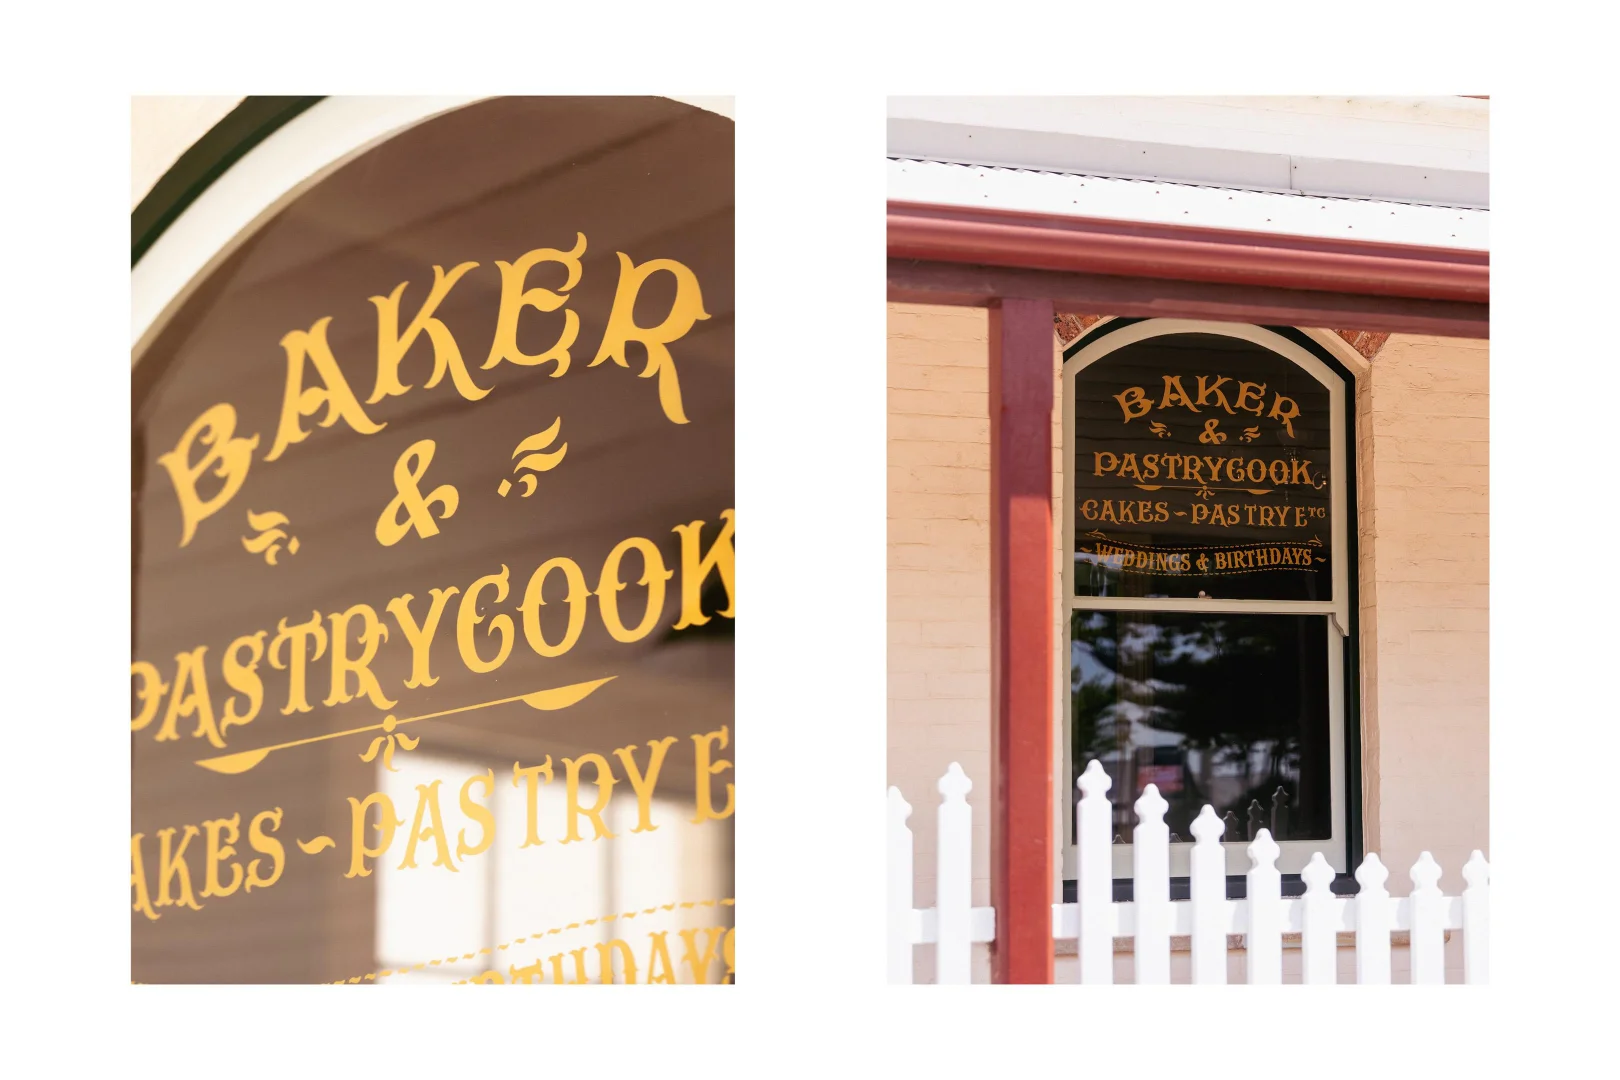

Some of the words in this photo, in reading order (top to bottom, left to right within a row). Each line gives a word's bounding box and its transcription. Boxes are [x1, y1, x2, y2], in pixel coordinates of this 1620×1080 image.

[156, 230, 713, 549] BAKER
[1113, 374, 1302, 439] BAKER
[1198, 418, 1228, 445] &
[1093, 451, 1314, 485] PASTRYCOOK
[374, 438, 461, 548] &
[1079, 498, 1170, 525] CAKES
[1191, 503, 1292, 528] PASTRY
[1095, 542, 1192, 572] WEDDINGS
[1195, 552, 1210, 573] &
[1215, 547, 1313, 570] BIRTHDAYS
